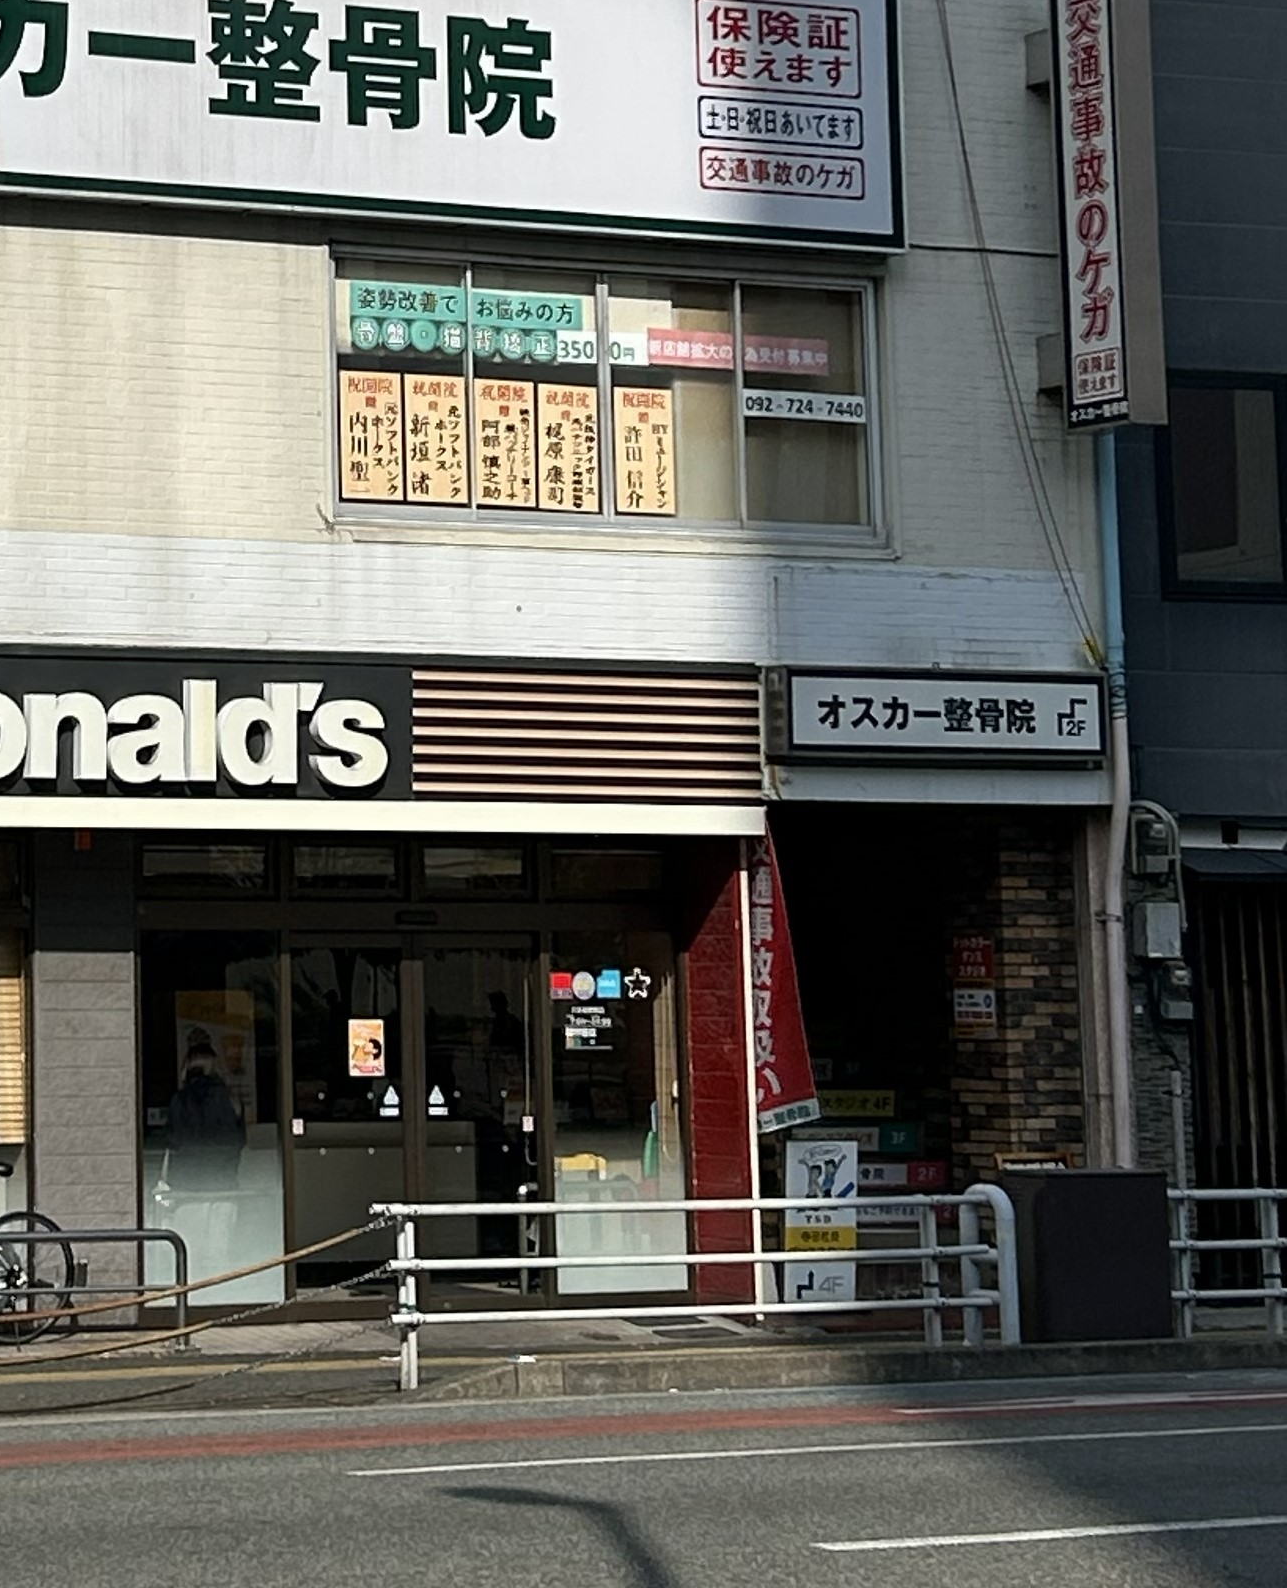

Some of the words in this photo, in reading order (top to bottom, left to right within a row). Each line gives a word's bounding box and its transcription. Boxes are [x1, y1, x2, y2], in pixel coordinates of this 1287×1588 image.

[706, 5, 850, 51] 保険証
[706, 46, 851, 87] 使えます
[706, 156, 856, 190] 交通事故のケガ
[434, 418, 448, 471] ホークス
[818, 695, 1036, 735] オスカー整骨院
[1066, 720, 1086, 737] 2F
[873, 1096, 892, 1111] 4F
[890, 1131, 906, 1145] 3F
[917, 1166, 937, 1181] 2F
[819, 1275, 845, 1294] 4F
